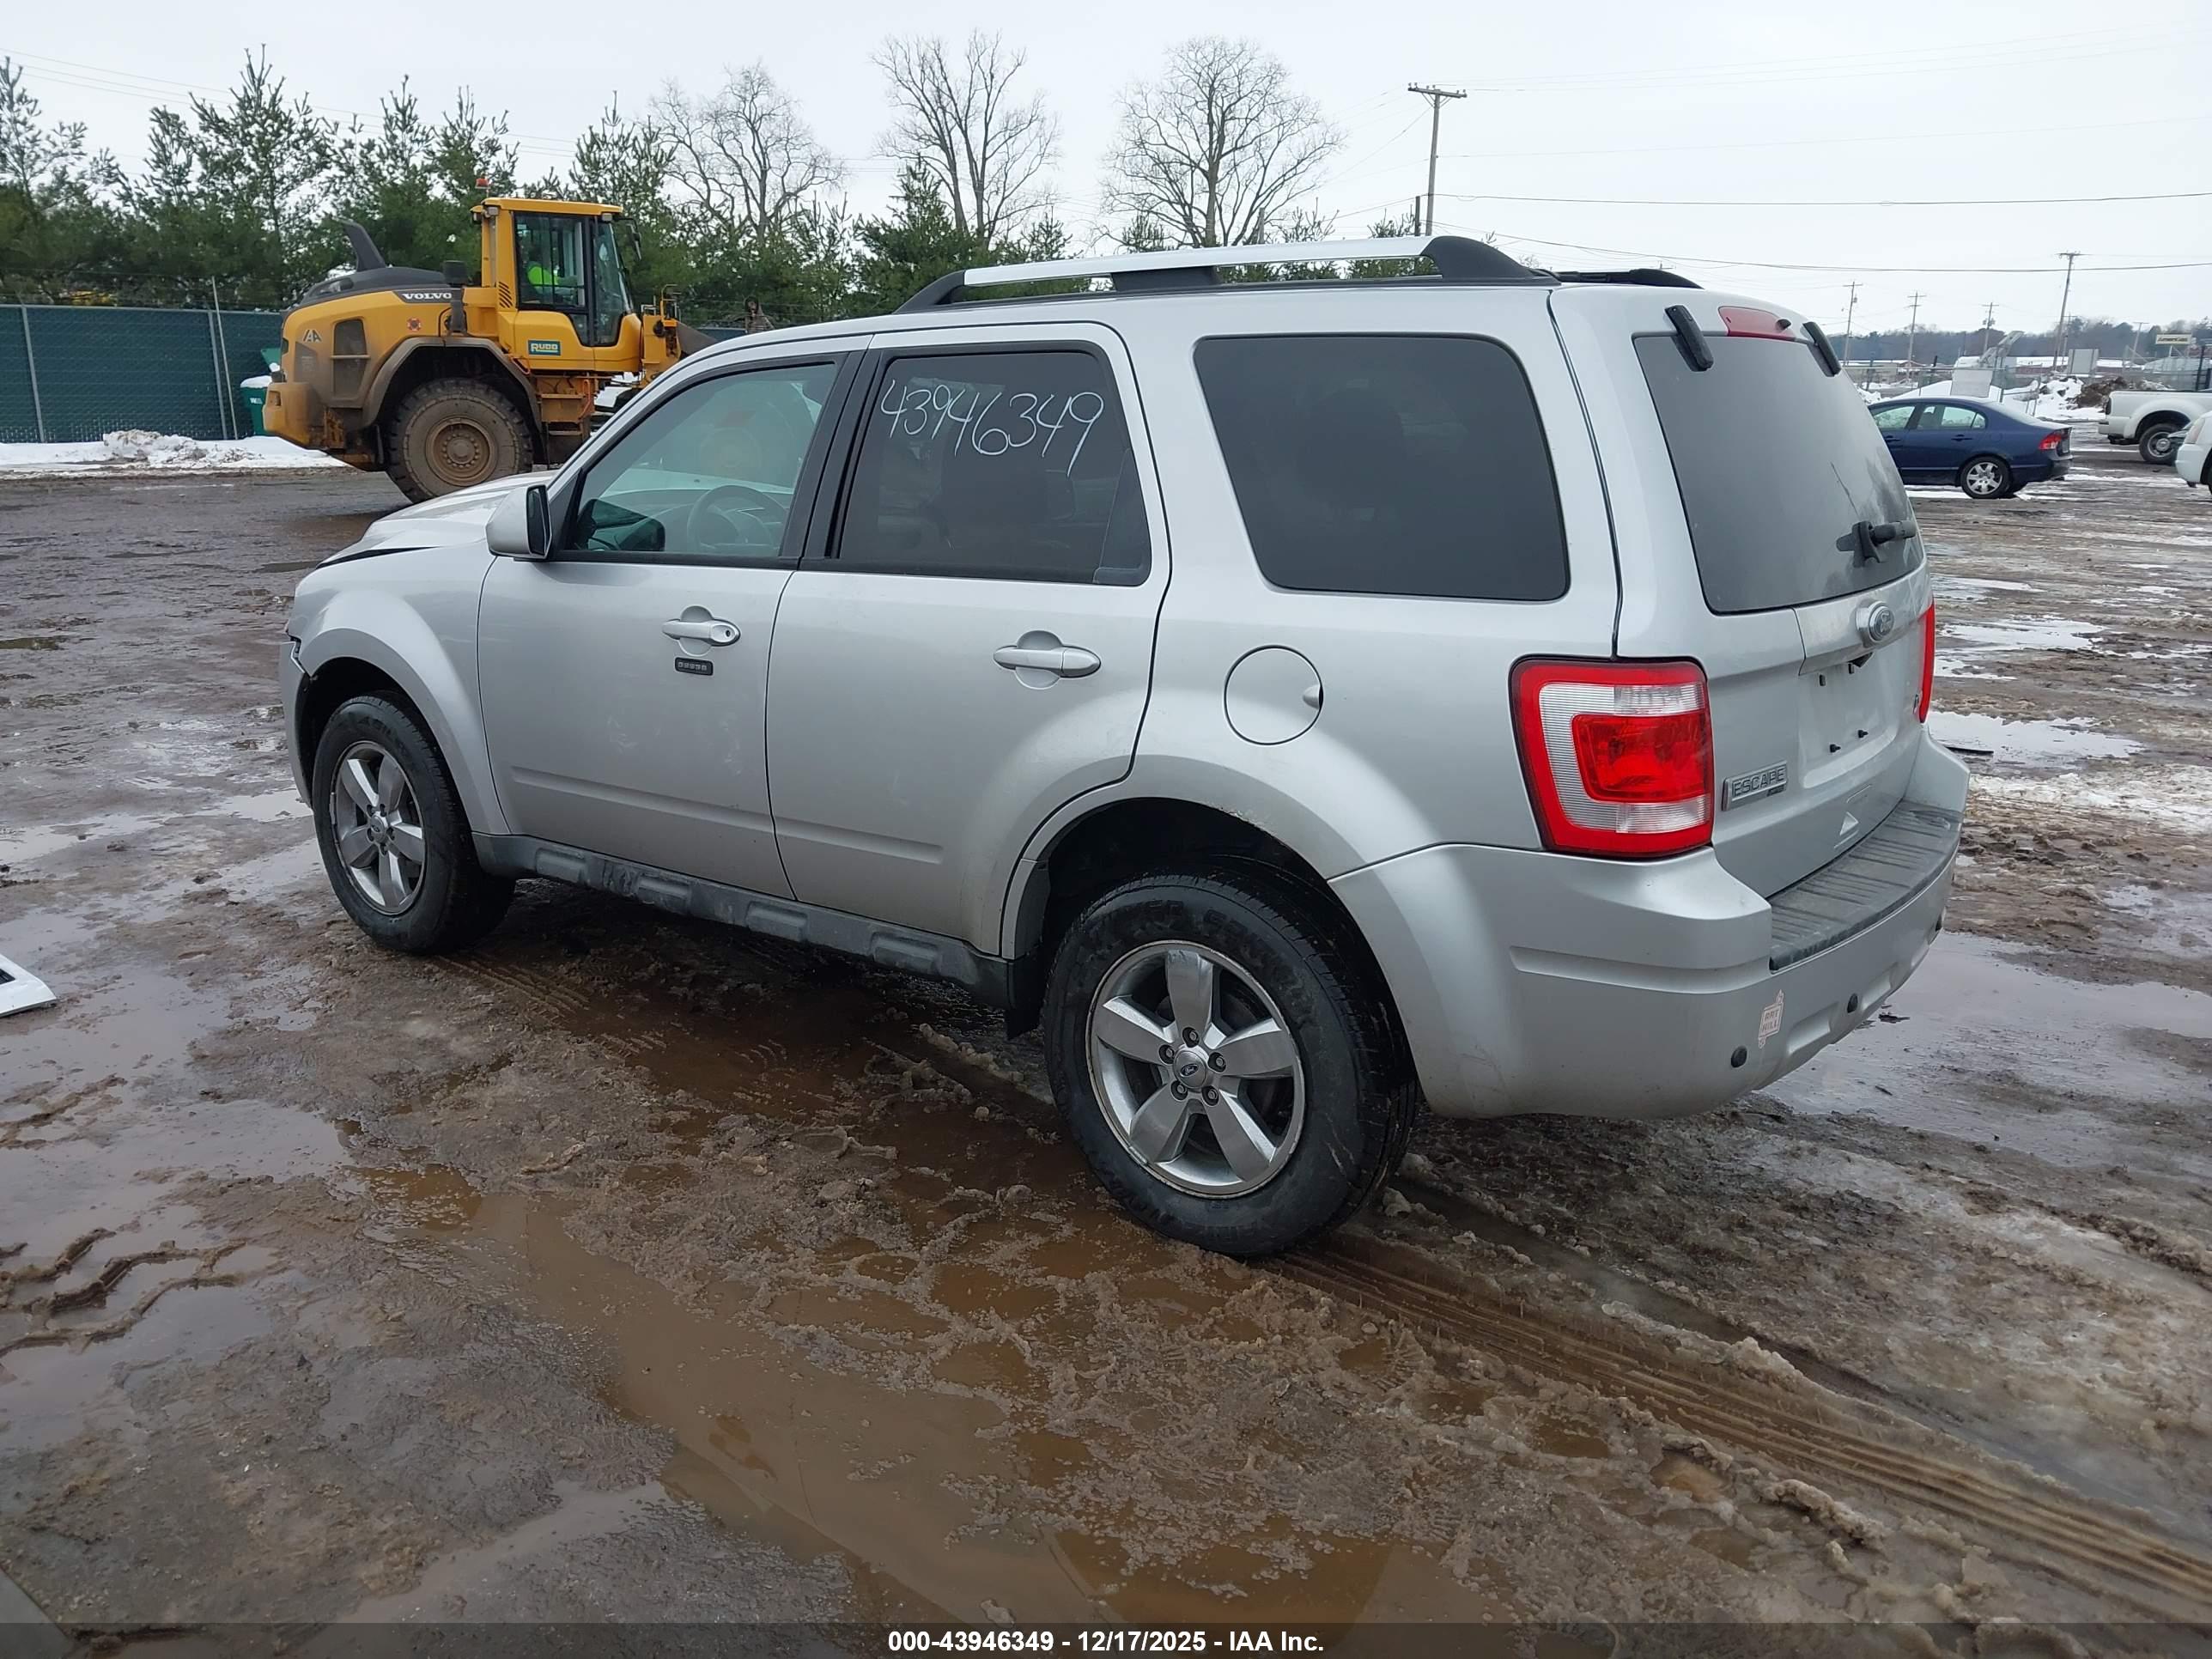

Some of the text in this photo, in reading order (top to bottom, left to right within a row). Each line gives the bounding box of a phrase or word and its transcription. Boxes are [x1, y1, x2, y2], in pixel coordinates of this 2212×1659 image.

[530, 343, 559, 353] RUDD
[880, 379, 1104, 477] 43946349
[1732, 765, 1786, 799] ESCAPE
